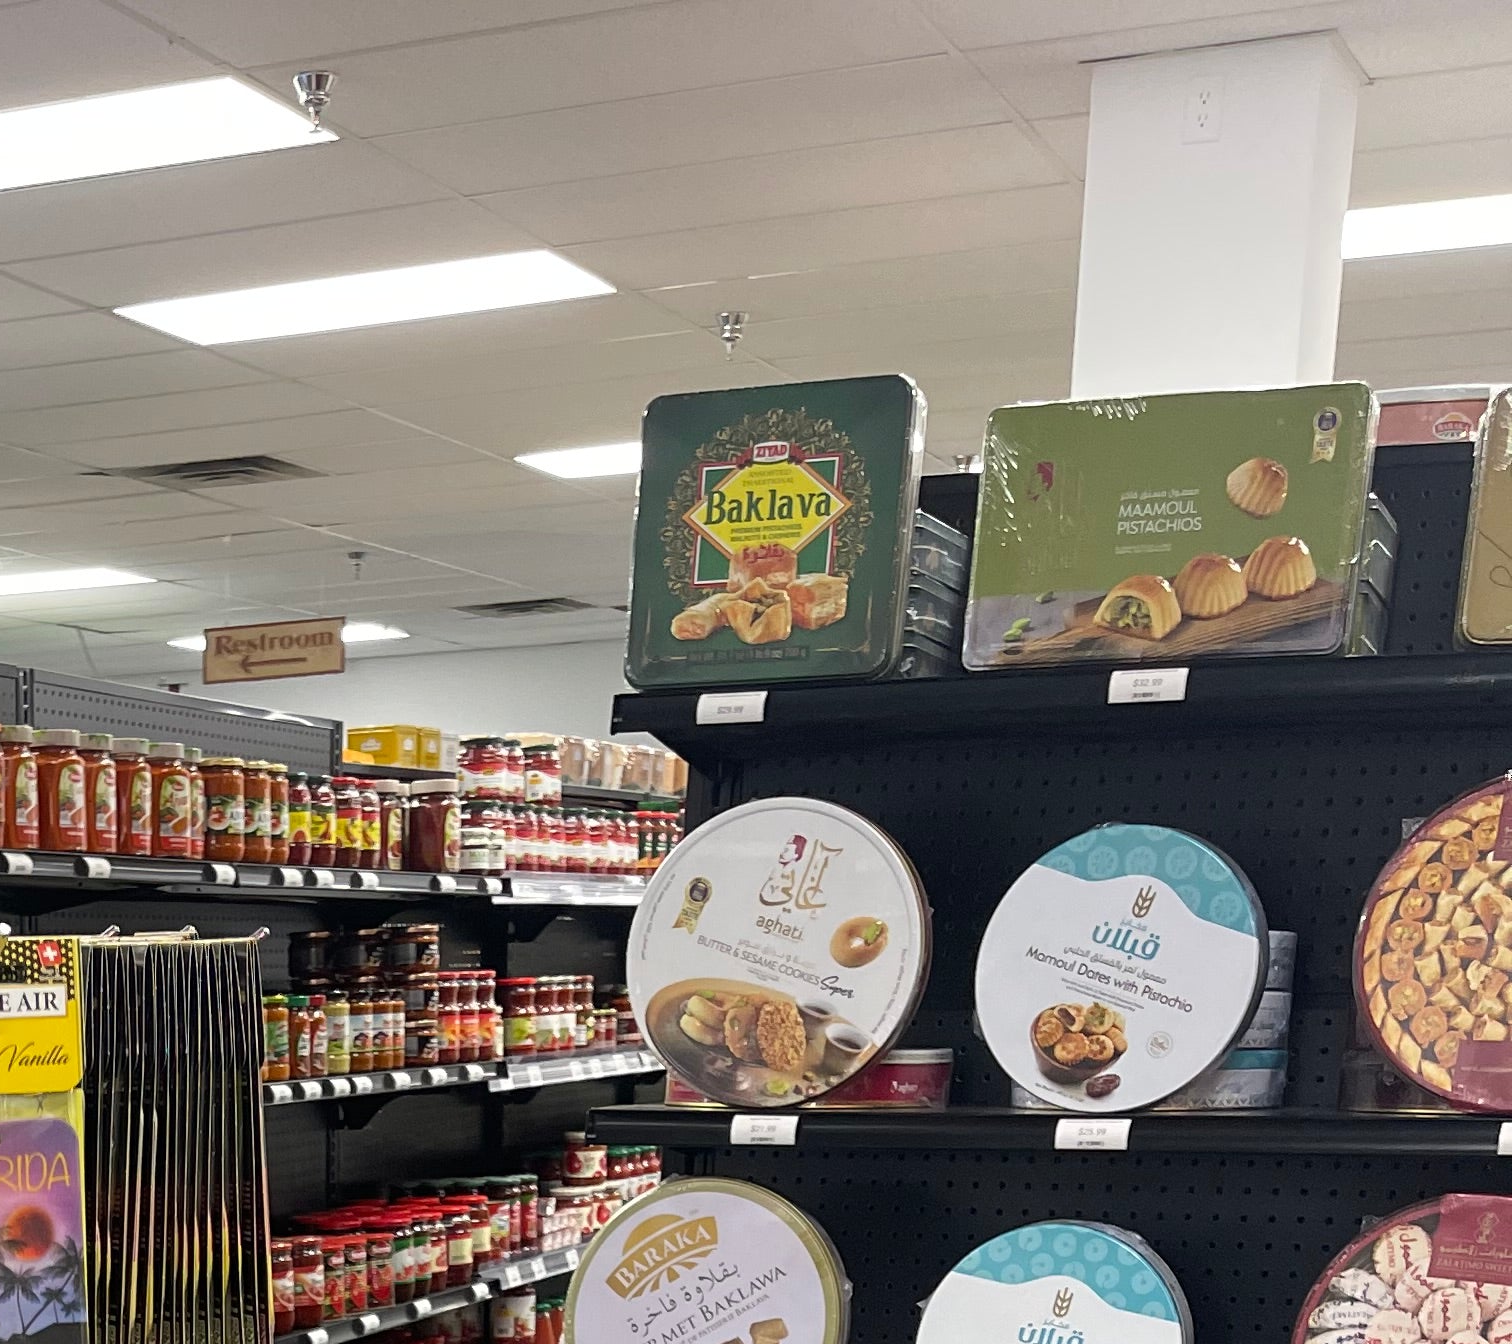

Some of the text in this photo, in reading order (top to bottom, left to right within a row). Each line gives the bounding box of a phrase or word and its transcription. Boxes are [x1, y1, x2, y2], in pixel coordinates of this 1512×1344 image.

[756, 445, 787, 458] ZIYAD
[704, 489, 831, 525] Baklava
[1119, 500, 1197, 517] MAAMOUL
[1117, 517, 1202, 535] PISTACHIOS
[214, 631, 334, 656] Restroom
[756, 914, 803, 940] aghati
[1092, 921, 1160, 960] قبلان
[697, 935, 732, 955] BUTTER
[733, 948, 739, 958] &
[740, 951, 778, 971] SESAME
[778, 963, 820, 986] COOKIES
[1026, 946, 1076, 972] Mamoul
[1077, 962, 1111, 985] Dates
[1114, 977, 1138, 994] with
[1141, 985, 1193, 1013] Pistachio
[13, 991, 61, 1013] AIR
[6, 1041, 71, 1069] Vanilla
[615, 1224, 712, 1288] BARAKA
[699, 1266, 787, 1323] BAKLAWA
